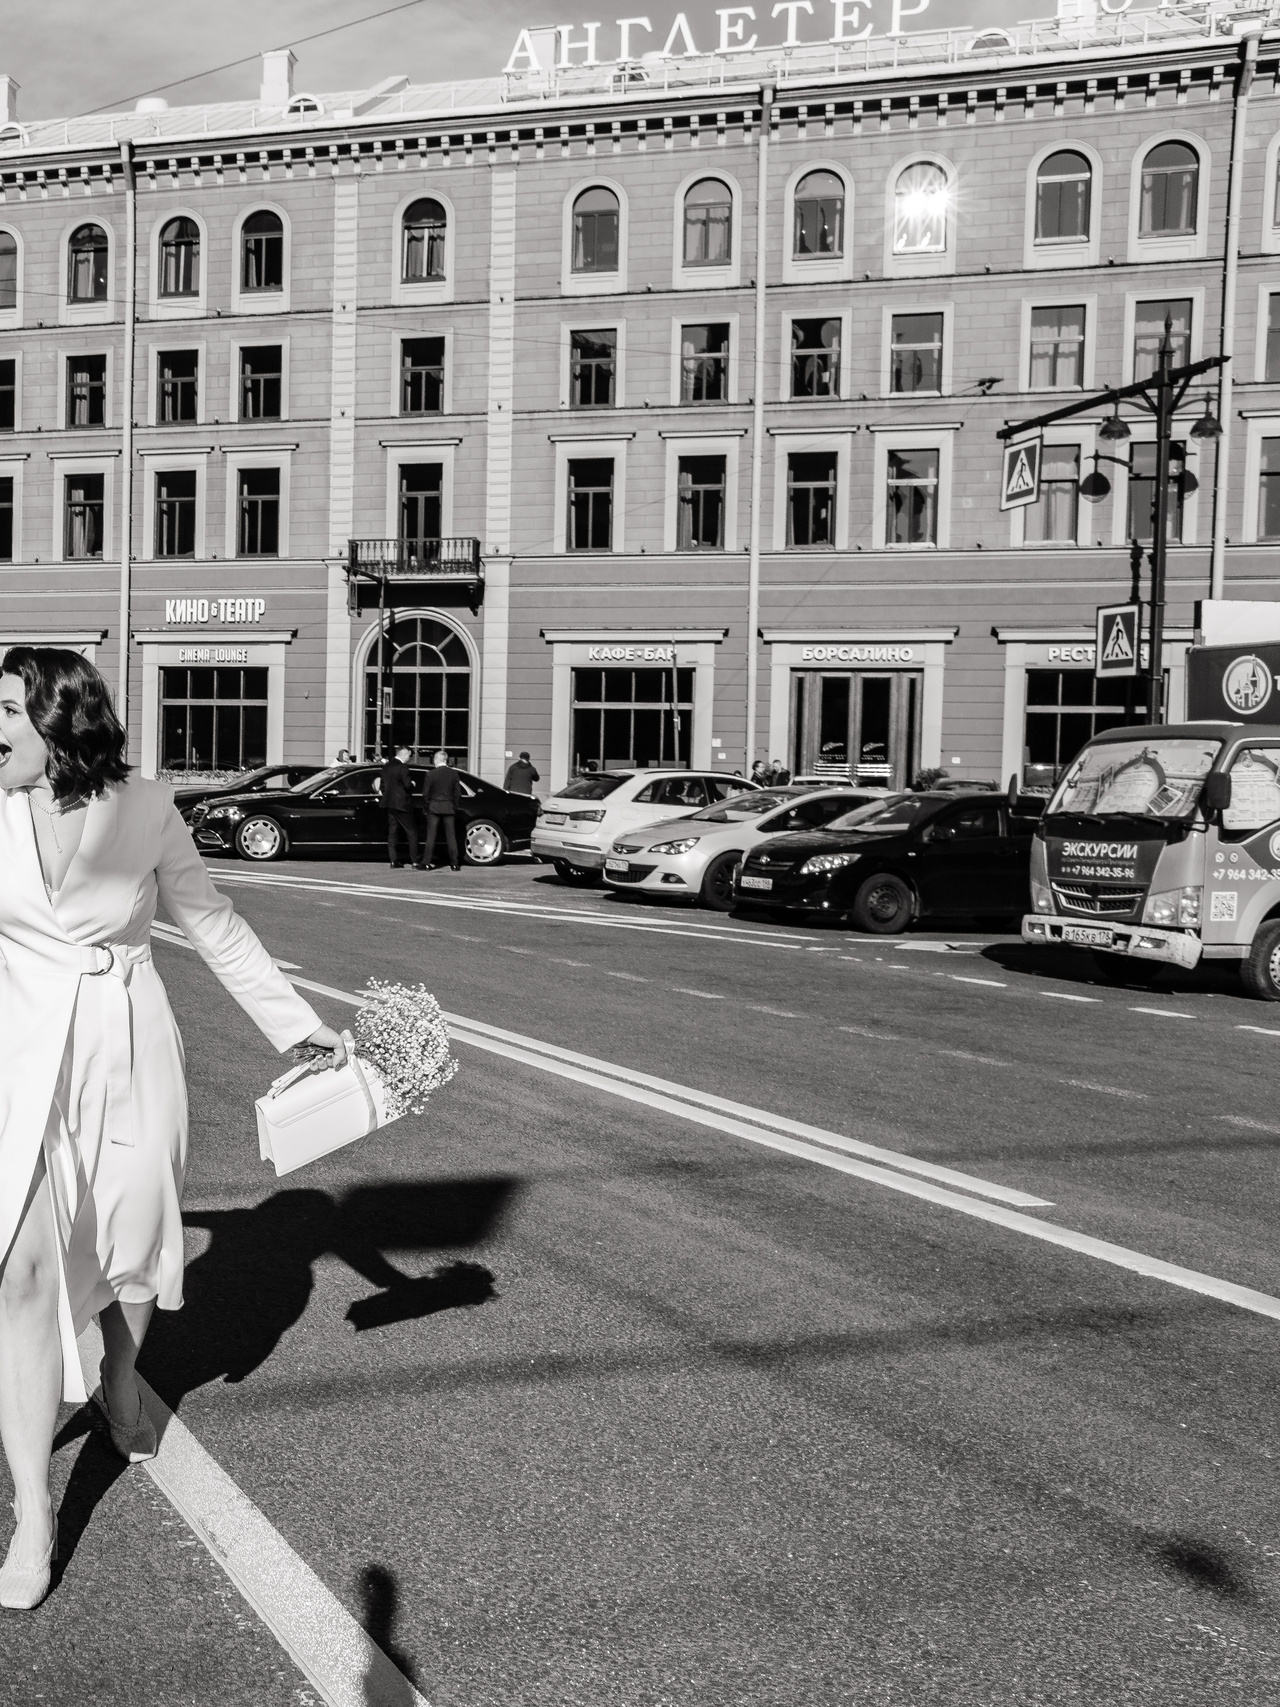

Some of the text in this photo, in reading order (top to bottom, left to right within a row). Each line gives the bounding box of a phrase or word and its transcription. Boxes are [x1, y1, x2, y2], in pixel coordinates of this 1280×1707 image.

[502, 0, 931, 72] АНГЛЕТЕР
[179, 648, 248, 664] CINEMA LOUNGE
[801, 646, 914, 662] БОРСАЛИНО
[1061, 841, 1139, 859] ЭКСКУРСИИ
[1072, 865, 1081, 875] +7
[1081, 866, 1095, 876] 964
[1213, 868, 1226, 880] +7
[1227, 868, 1247, 880] 964
